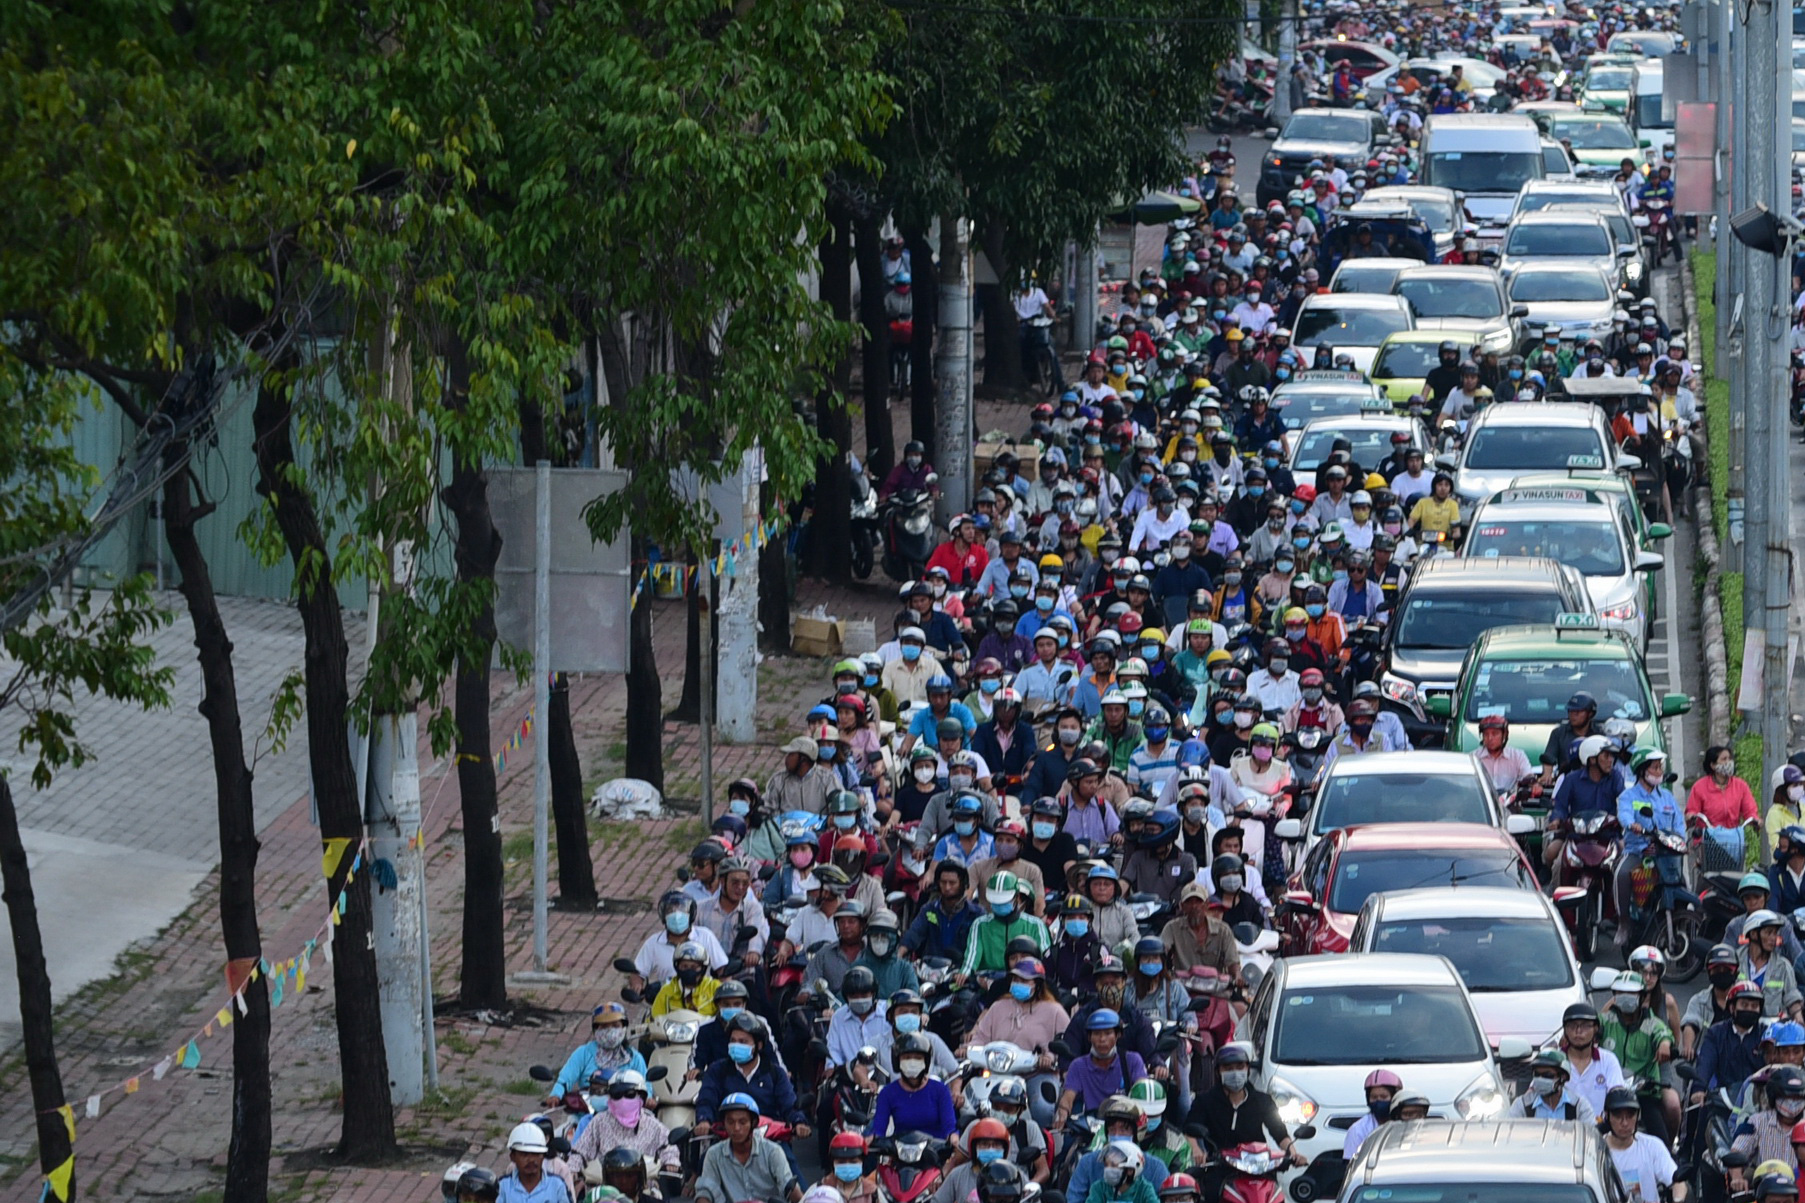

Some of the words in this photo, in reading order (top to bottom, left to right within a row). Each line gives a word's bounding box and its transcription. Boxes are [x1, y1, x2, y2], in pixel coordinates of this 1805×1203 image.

[1309, 371, 1345, 380] VINASUN
[1521, 490, 1564, 500] VINASUN
[1564, 490, 1583, 500] TAXI
[1559, 614, 1595, 627] TAXI
